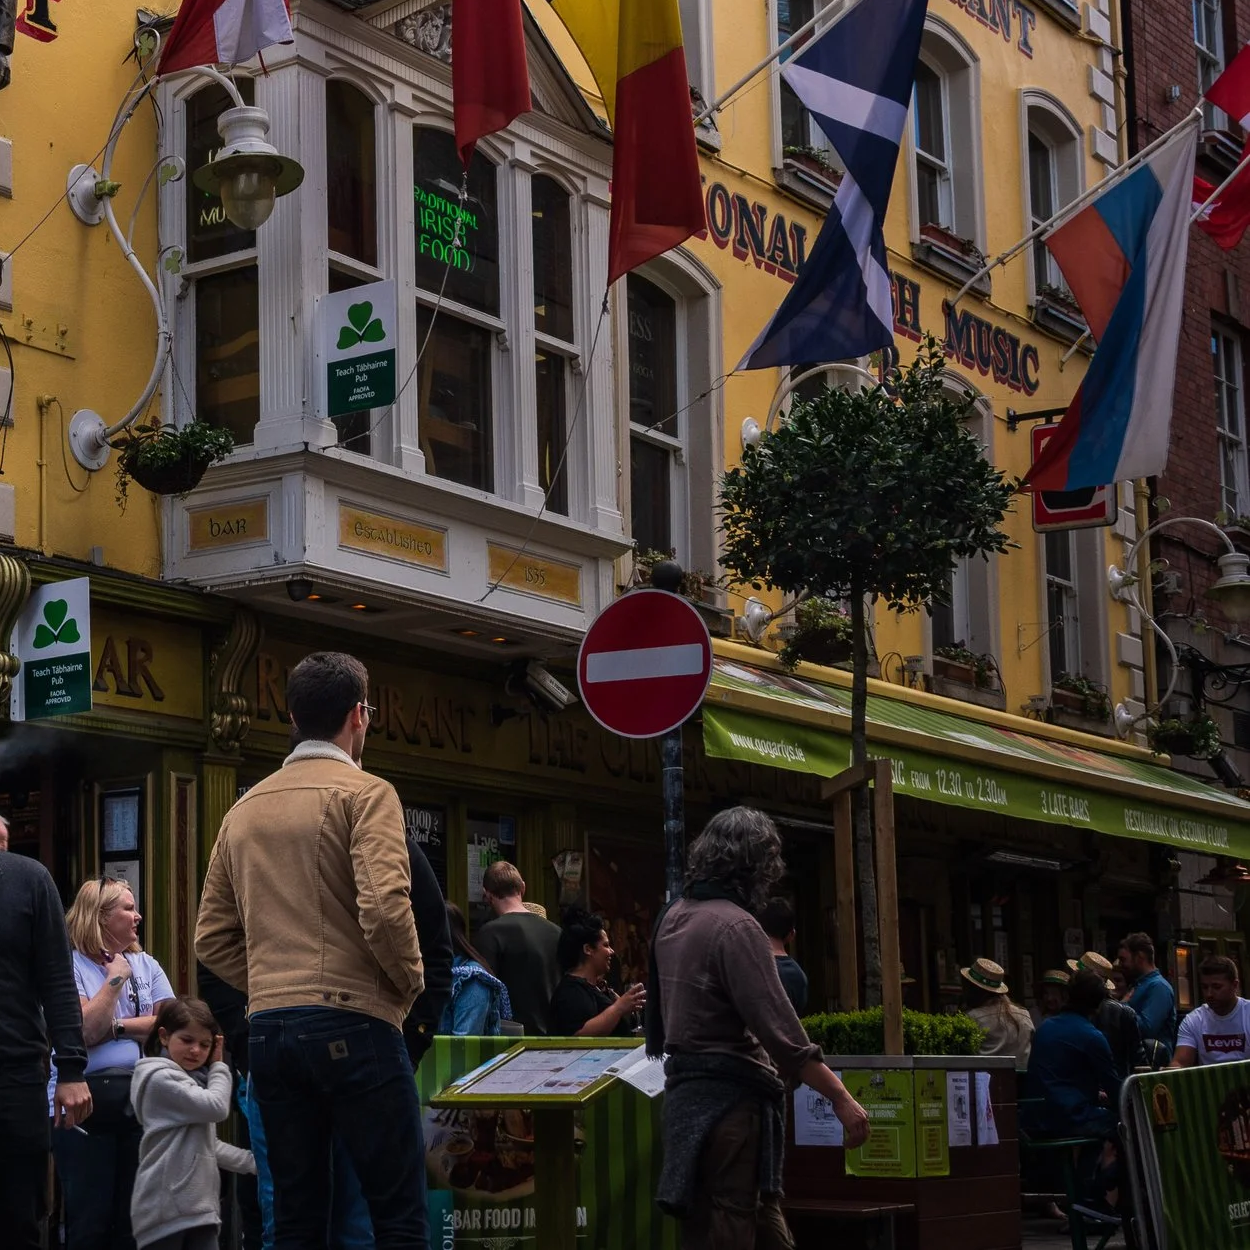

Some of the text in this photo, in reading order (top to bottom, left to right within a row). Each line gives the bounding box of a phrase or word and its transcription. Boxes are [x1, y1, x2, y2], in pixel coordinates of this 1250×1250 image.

[419, 232, 471, 272] FOOD
[941, 297, 1041, 398] MUSIC
[335, 365, 355, 378] Teach
[354, 372, 368, 384] Pub
[31, 666, 51, 678] Teach
[51, 675, 65, 686] Pub
[93, 634, 166, 702] AR
[910, 769, 933, 791] FROM
[935, 768, 963, 797] 12.30
[1040, 789, 1091, 823] 3 LATE BARS
[1123, 807, 1169, 839] RESTAURANT
[1179, 817, 1208, 845] SECOND
[1206, 824, 1230, 849] FLOOR
[453, 1207, 482, 1231] BAR
[483, 1206, 522, 1231] FOOD
